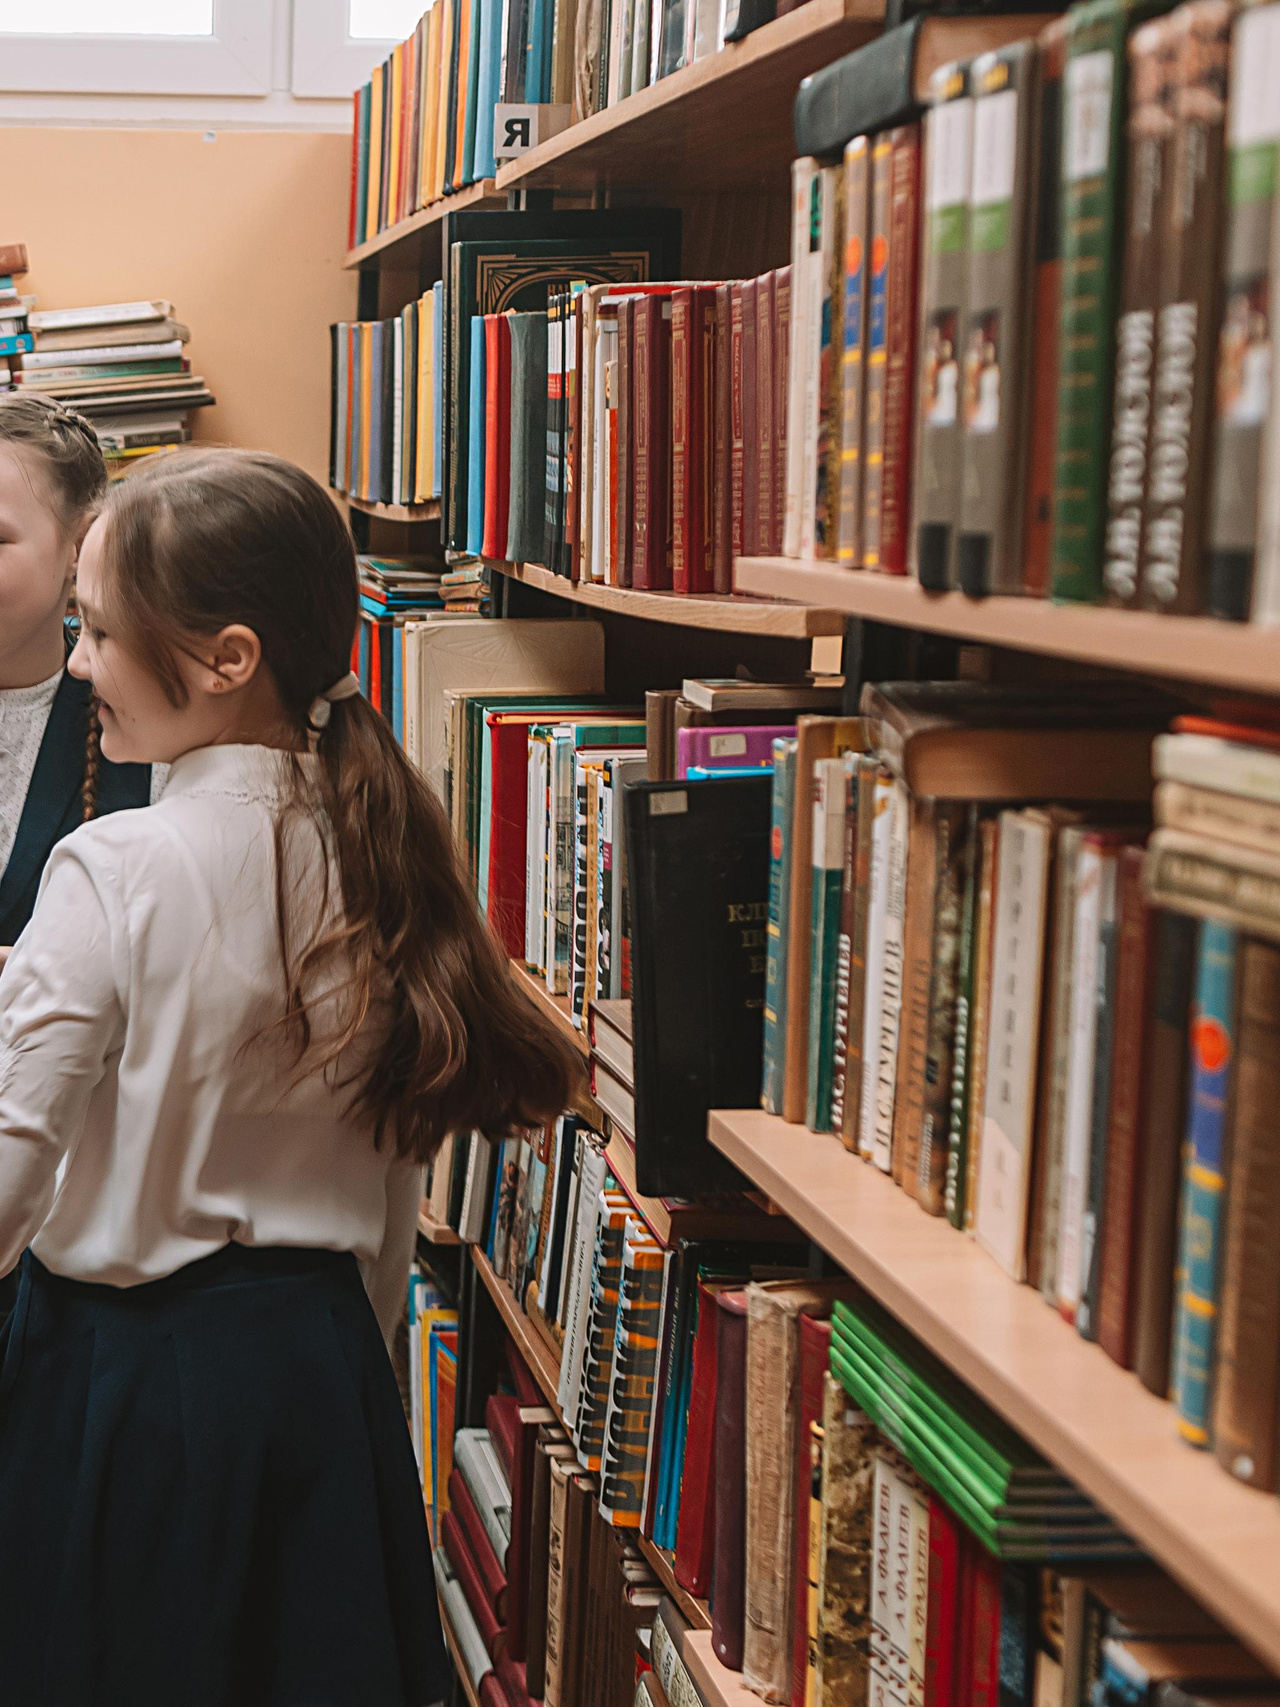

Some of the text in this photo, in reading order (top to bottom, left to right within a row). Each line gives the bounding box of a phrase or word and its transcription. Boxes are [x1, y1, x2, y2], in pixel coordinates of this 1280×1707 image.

[503, 117, 530, 147] Я
[833, 933, 852, 1067] ТУРГЕНЕВ
[878, 940, 902, 1089] ТУРГЕНЕВ
[602, 1266, 665, 1511] РУССКАЯ
[665, 1285, 681, 1398] СЕРЕБРЯНЫЙ ВЕК
[877, 1483, 891, 1579] ФАДЕЕВ
[895, 1503, 910, 1600] ФАДЕЕВ
